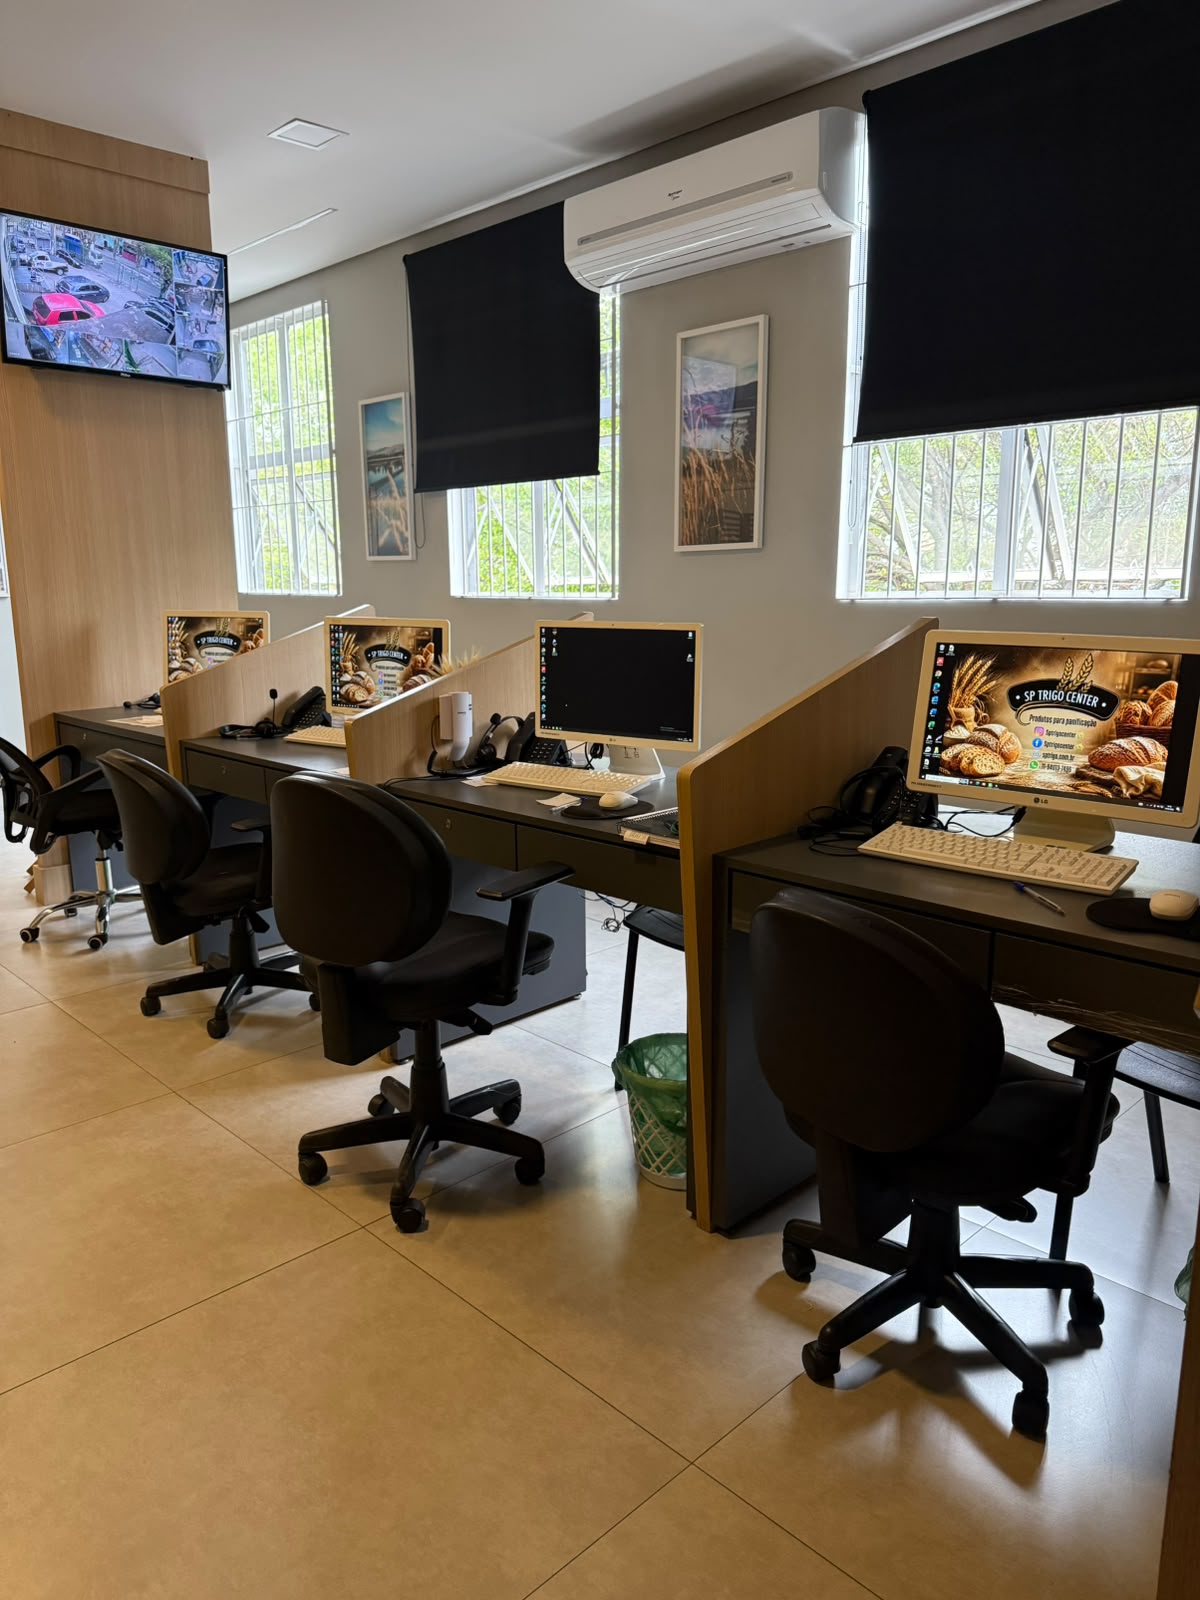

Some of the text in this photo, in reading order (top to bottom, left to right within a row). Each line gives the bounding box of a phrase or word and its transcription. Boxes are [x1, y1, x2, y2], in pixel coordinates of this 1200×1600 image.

[1024, 690, 1099, 708] SP TRIGO CENTER
[1029, 714, 1052, 724] Produtos
[1053, 717, 1065, 725] para
